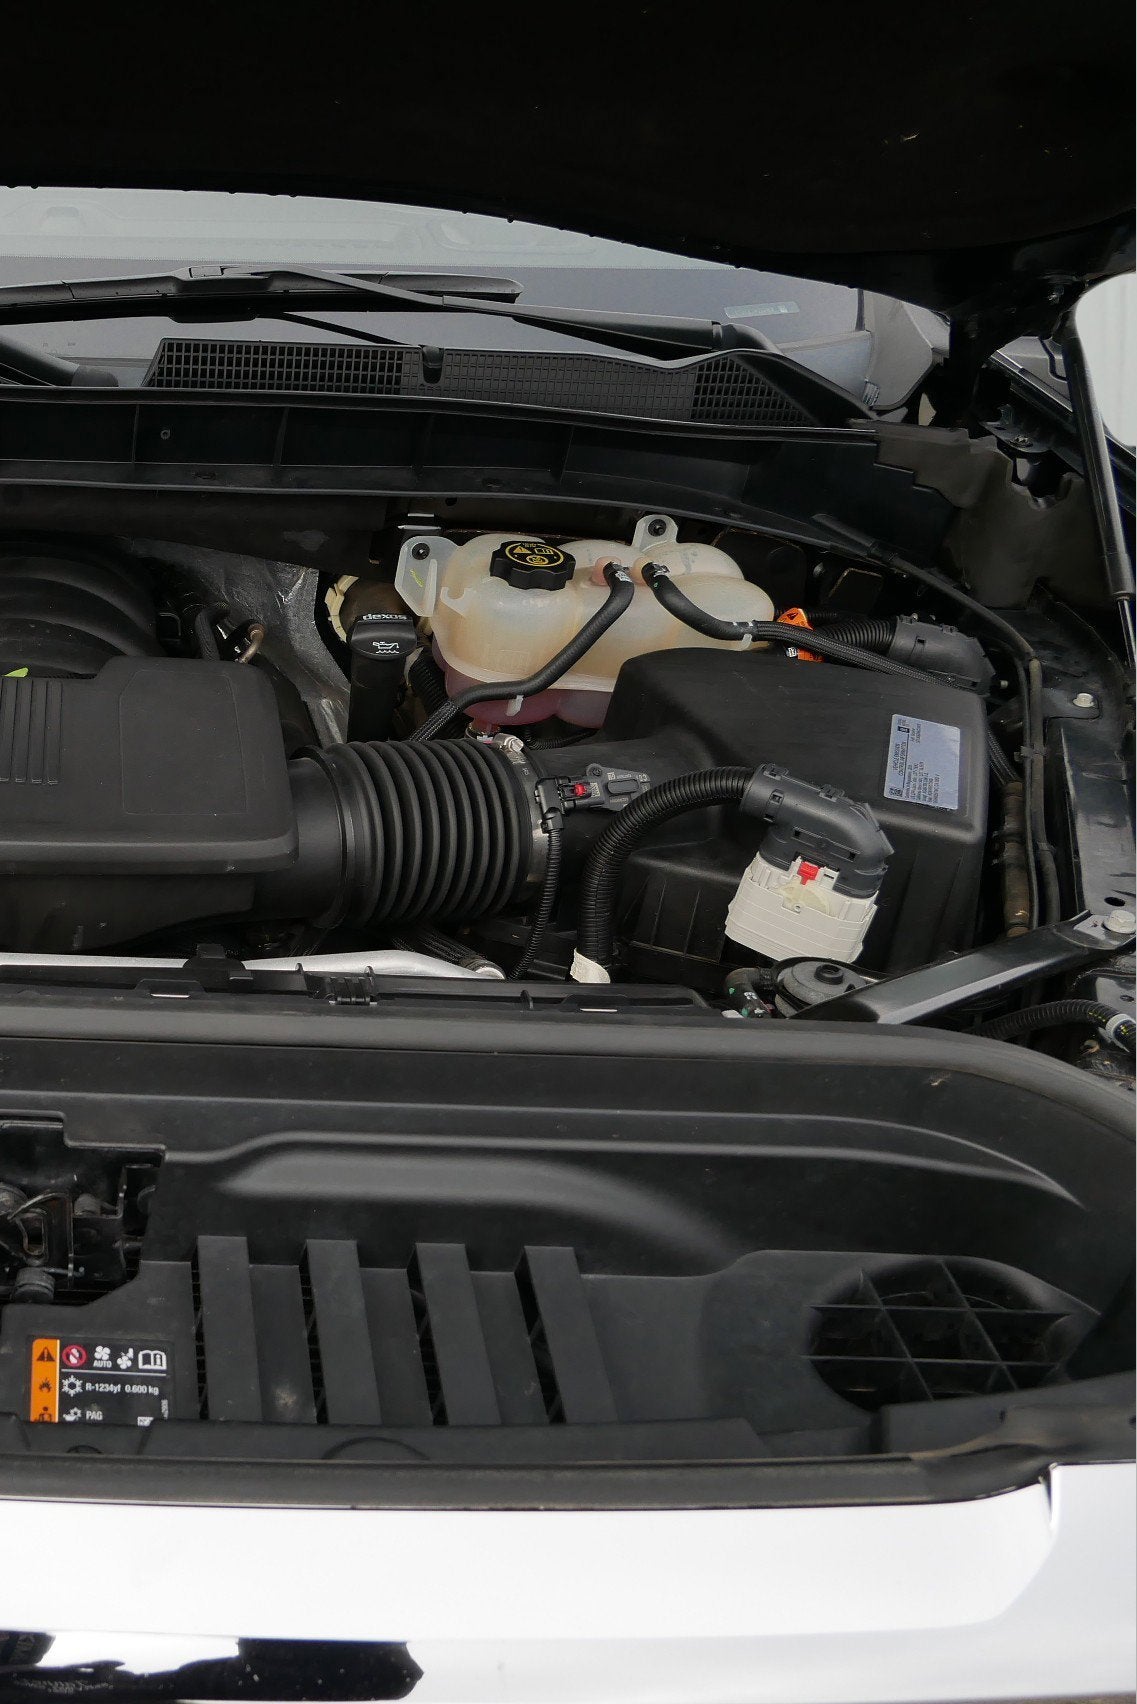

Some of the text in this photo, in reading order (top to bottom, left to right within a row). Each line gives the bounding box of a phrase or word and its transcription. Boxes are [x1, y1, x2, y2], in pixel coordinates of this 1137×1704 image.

[93, 1360, 112, 1368] AUTO
[85, 1383, 121, 1394] R-1234yf
[149, 1385, 159, 1396] kg
[86, 1411, 103, 1420] PAG
